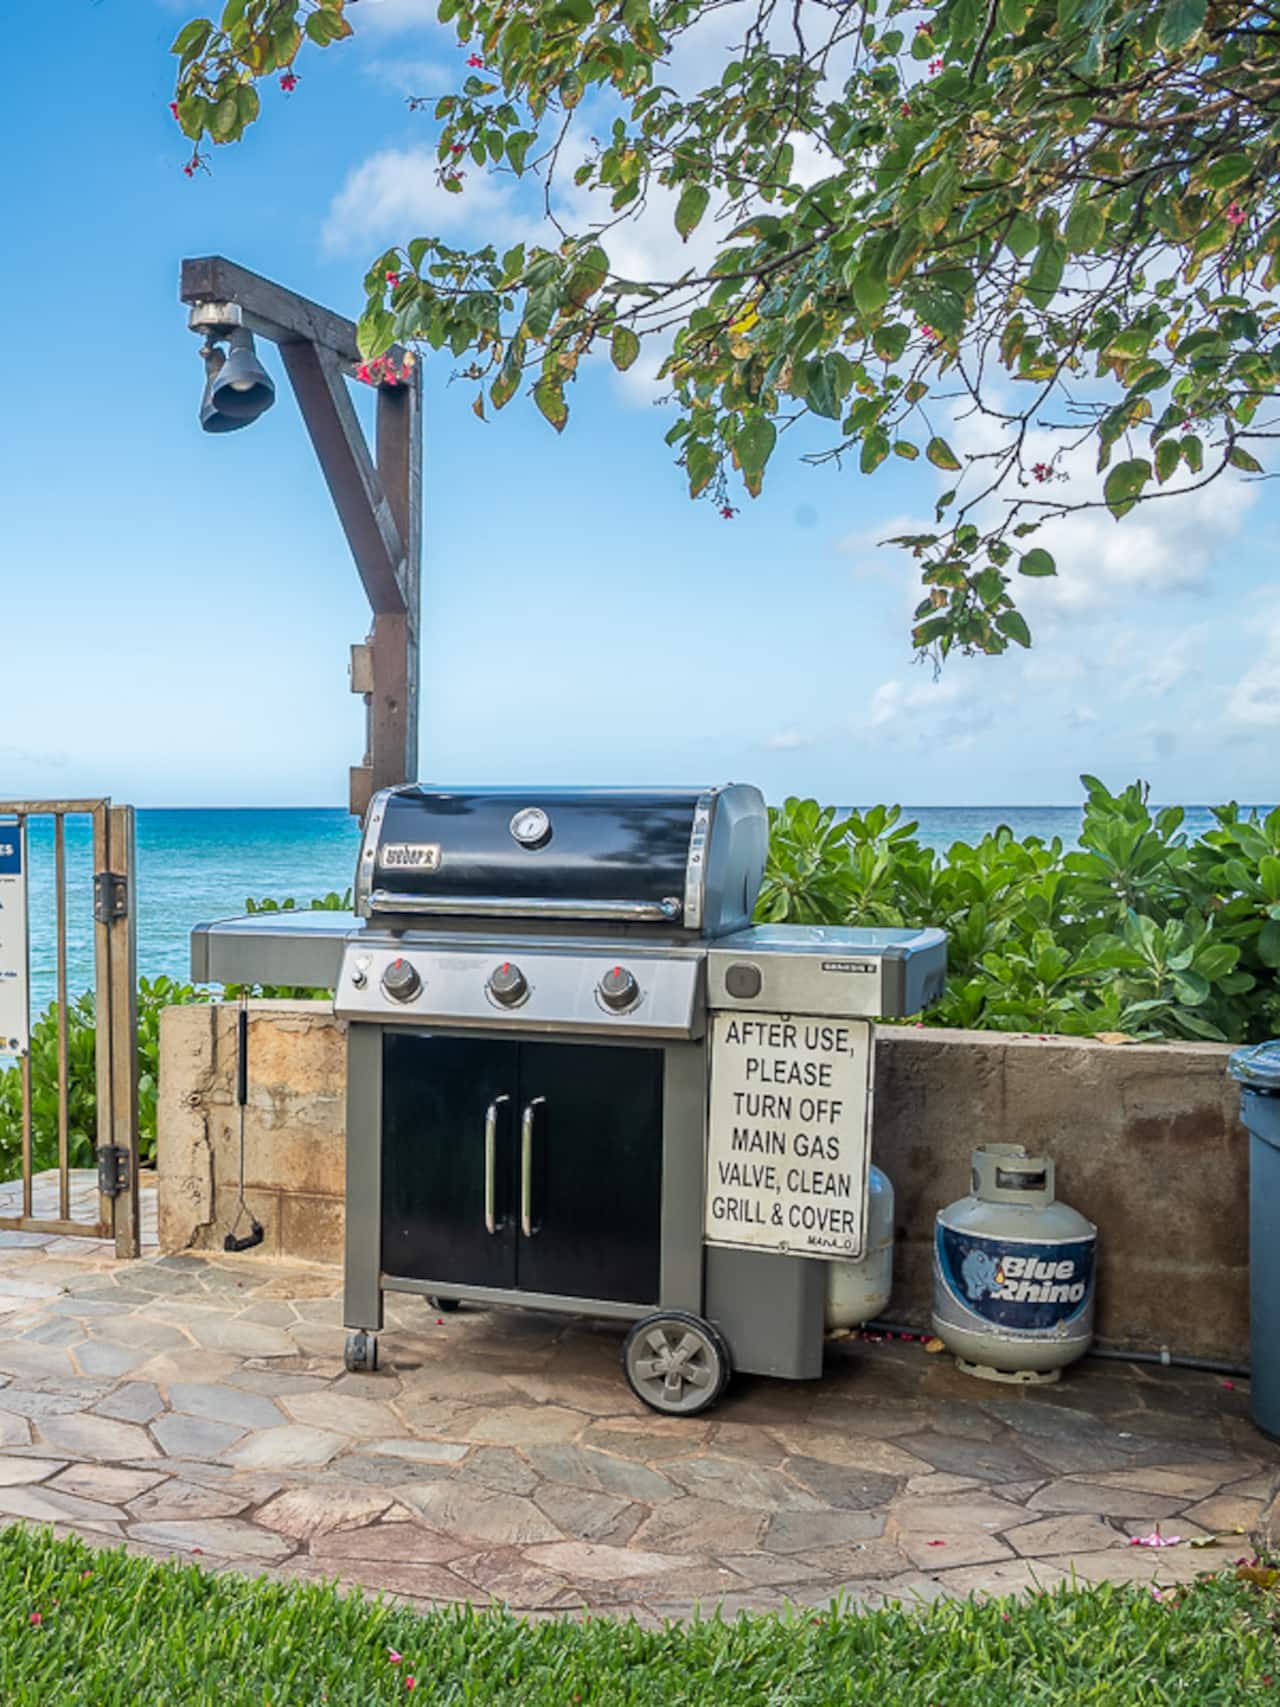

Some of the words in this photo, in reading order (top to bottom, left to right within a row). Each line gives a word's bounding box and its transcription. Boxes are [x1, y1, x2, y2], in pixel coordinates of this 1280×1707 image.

[725, 1020, 797, 1048] AFTER
[804, 1027, 855, 1057] USE,
[745, 1058, 833, 1087] PLEASE
[733, 1092, 792, 1120] TURN
[799, 1098, 843, 1124] OFF
[731, 1127, 786, 1155] MAIN
[793, 1133, 840, 1160] GAS
[718, 1161, 782, 1194] VALVE,
[786, 1168, 851, 1198] CLEAN
[711, 1196, 766, 1224] GRILL
[771, 1203, 784, 1226] &
[788, 1204, 855, 1234] COVER
[1000, 1255, 1075, 1280] Blue
[990, 1279, 1086, 1304] Rhino
